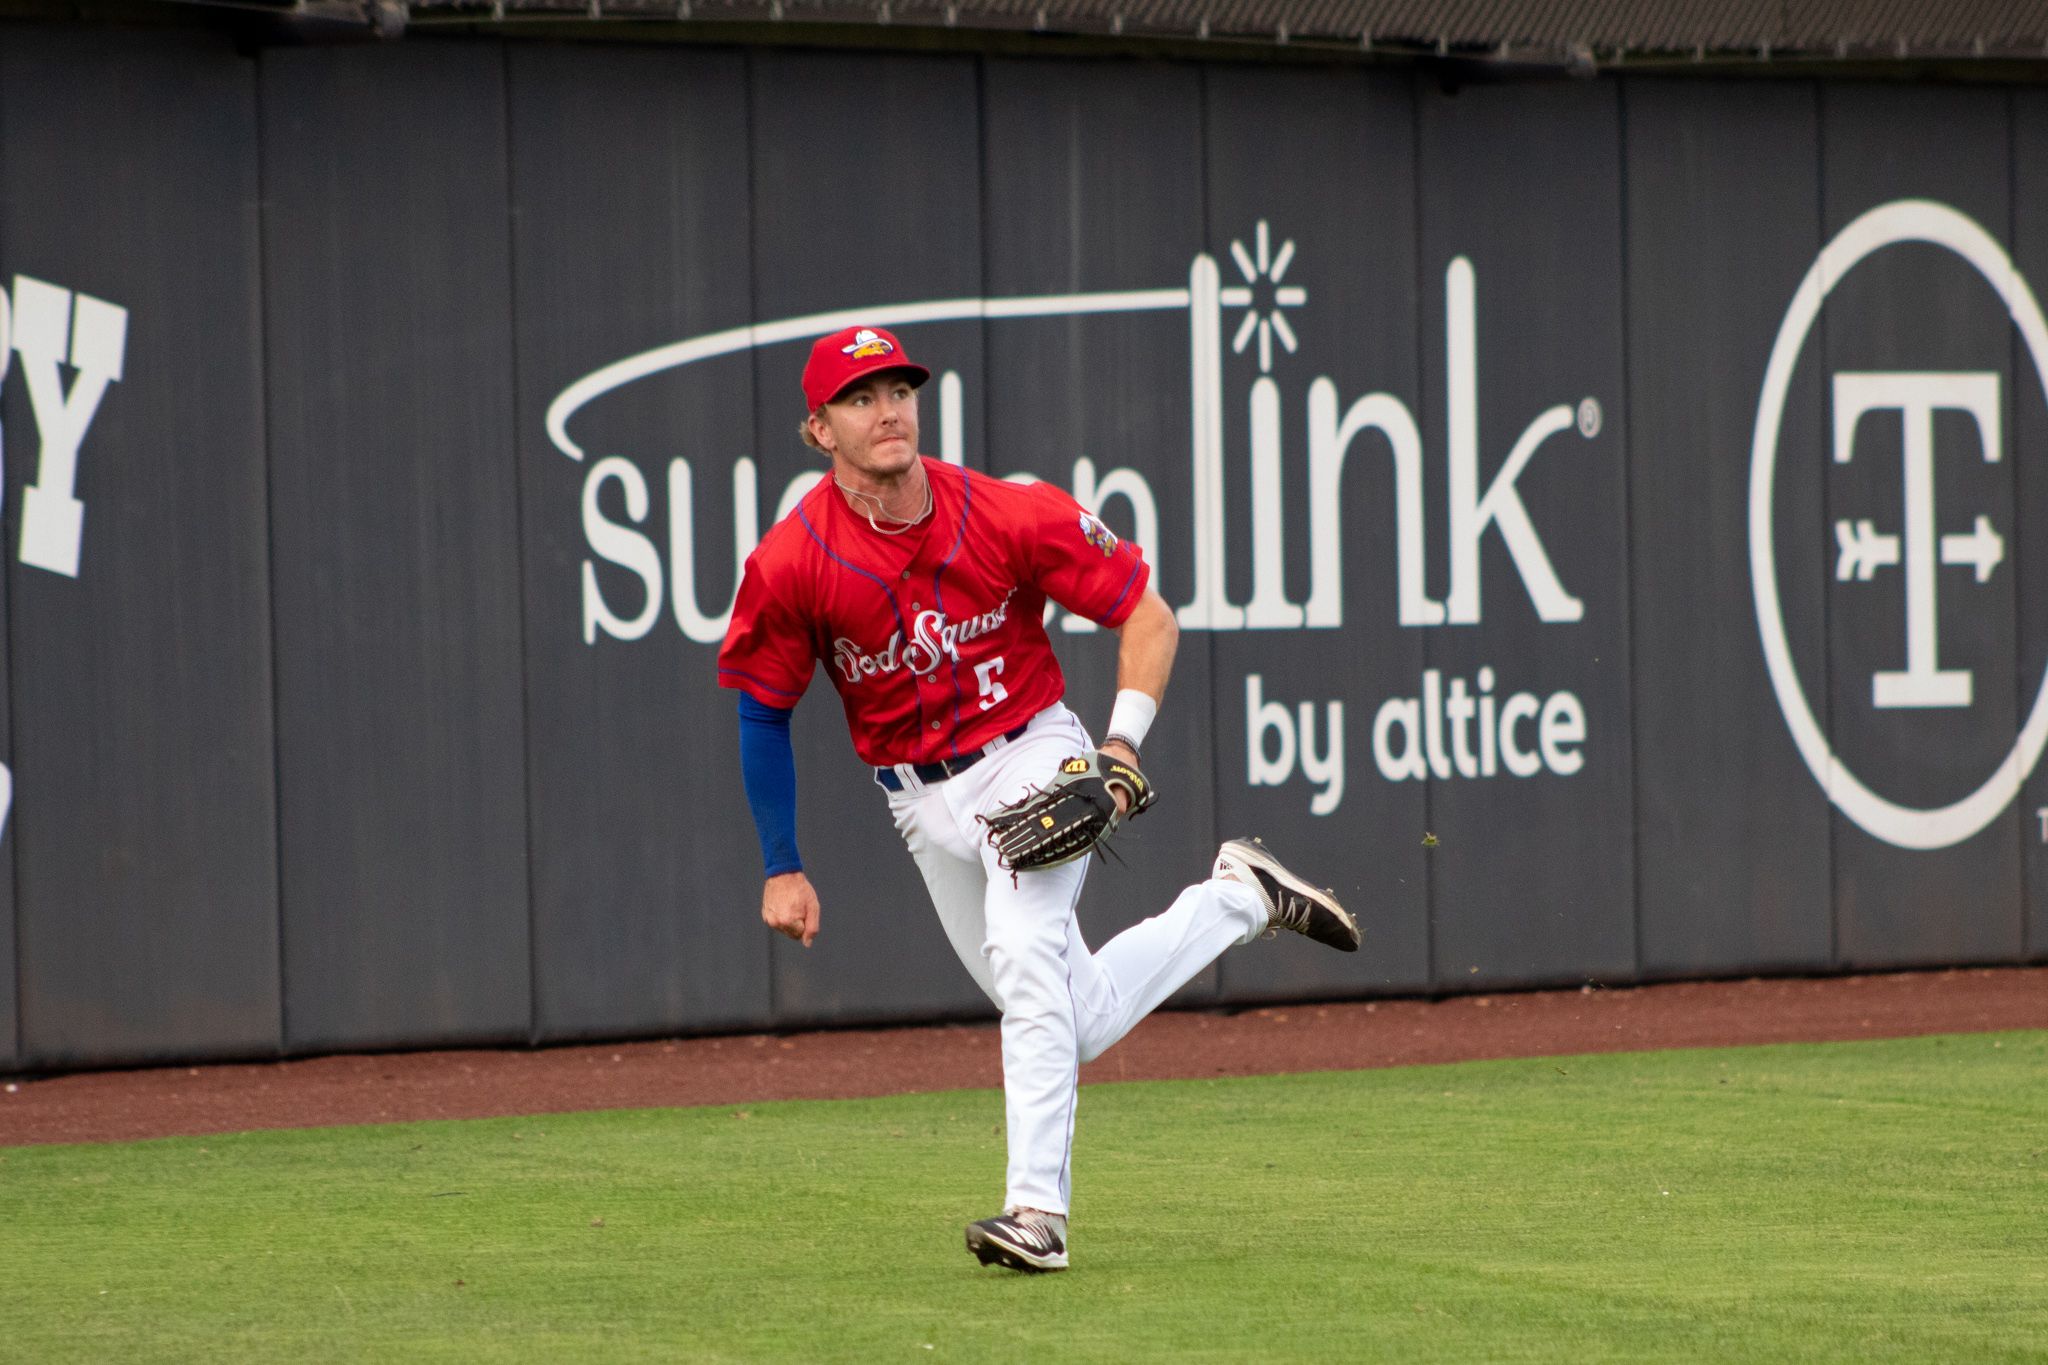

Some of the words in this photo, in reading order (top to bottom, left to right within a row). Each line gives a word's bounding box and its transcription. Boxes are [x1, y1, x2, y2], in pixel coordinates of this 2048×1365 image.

[0, 274, 128, 578] Y
[582, 253, 1584, 645] sunlink
[834, 631, 900, 683] Sod
[974, 656, 1008, 711] 5
[1246, 674, 1344, 815] by
[1373, 666, 1586, 781] altice
